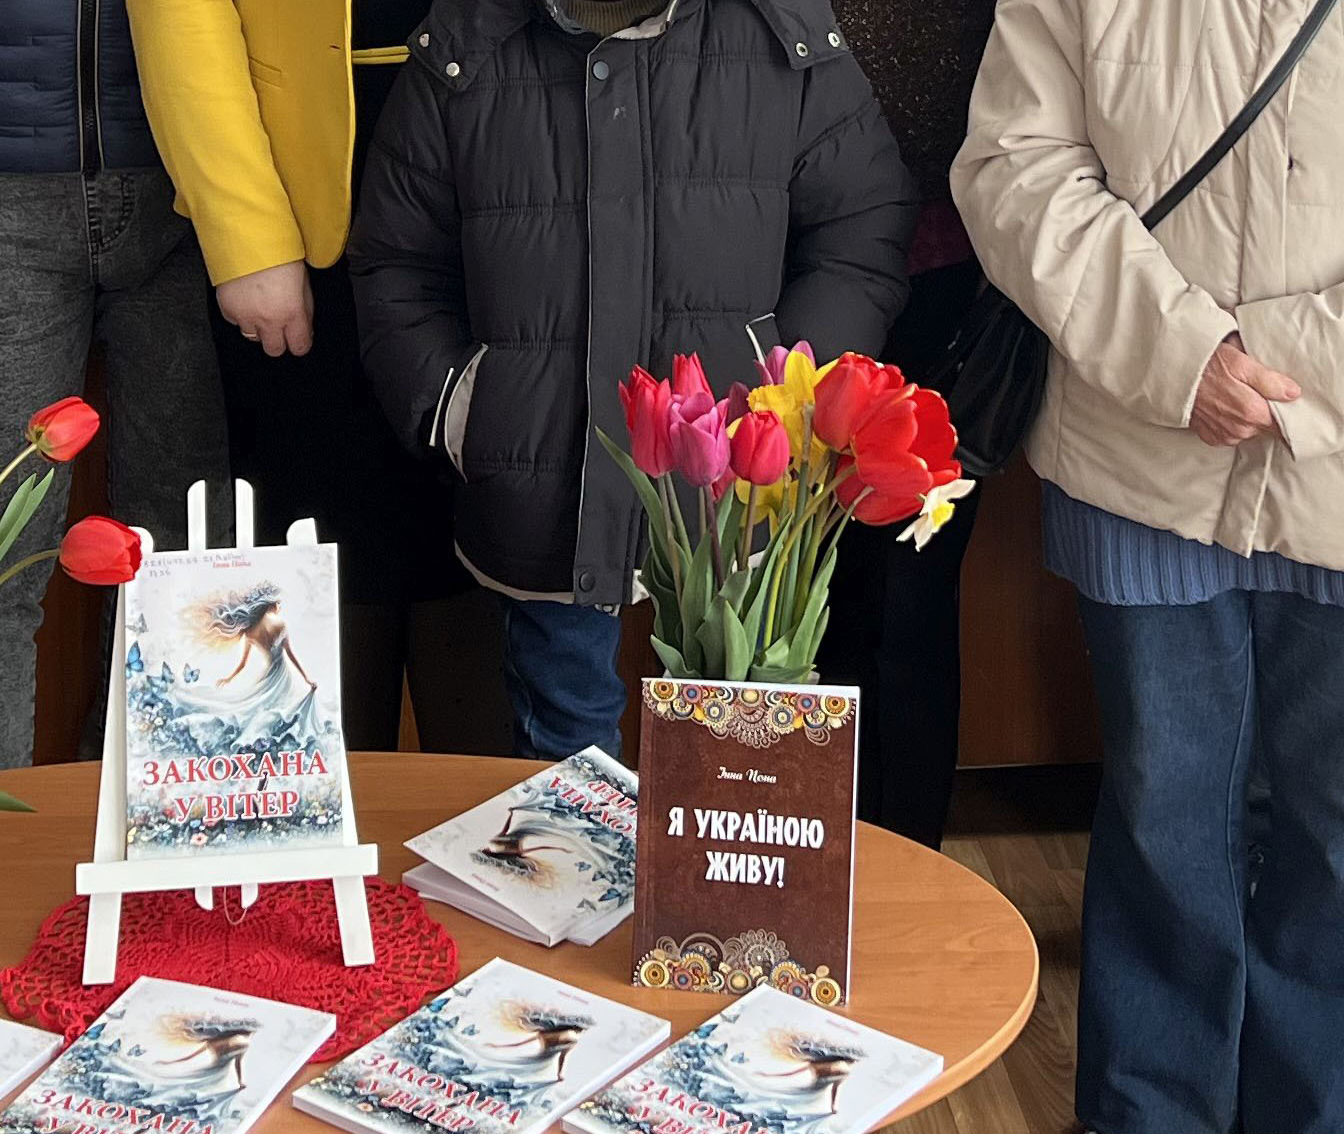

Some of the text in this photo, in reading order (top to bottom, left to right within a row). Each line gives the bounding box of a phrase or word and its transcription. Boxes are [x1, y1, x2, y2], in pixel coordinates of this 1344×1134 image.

[143, 750, 328, 786] ЗАКОХАНА
[716, 766, 743, 781] Інна
[175, 790, 299, 823] У ВІТЕР
[667, 807, 825, 849] Я УКРАЇНОЮ
[704, 852, 786, 889] ЖИВУ!
[359, 1051, 523, 1128] ЗАКОХАНА
[364, 1077, 477, 1132] У ВІТЕР
[32, 1088, 215, 1134] ЗАКОХАНА
[632, 1104, 651, 1123] У
